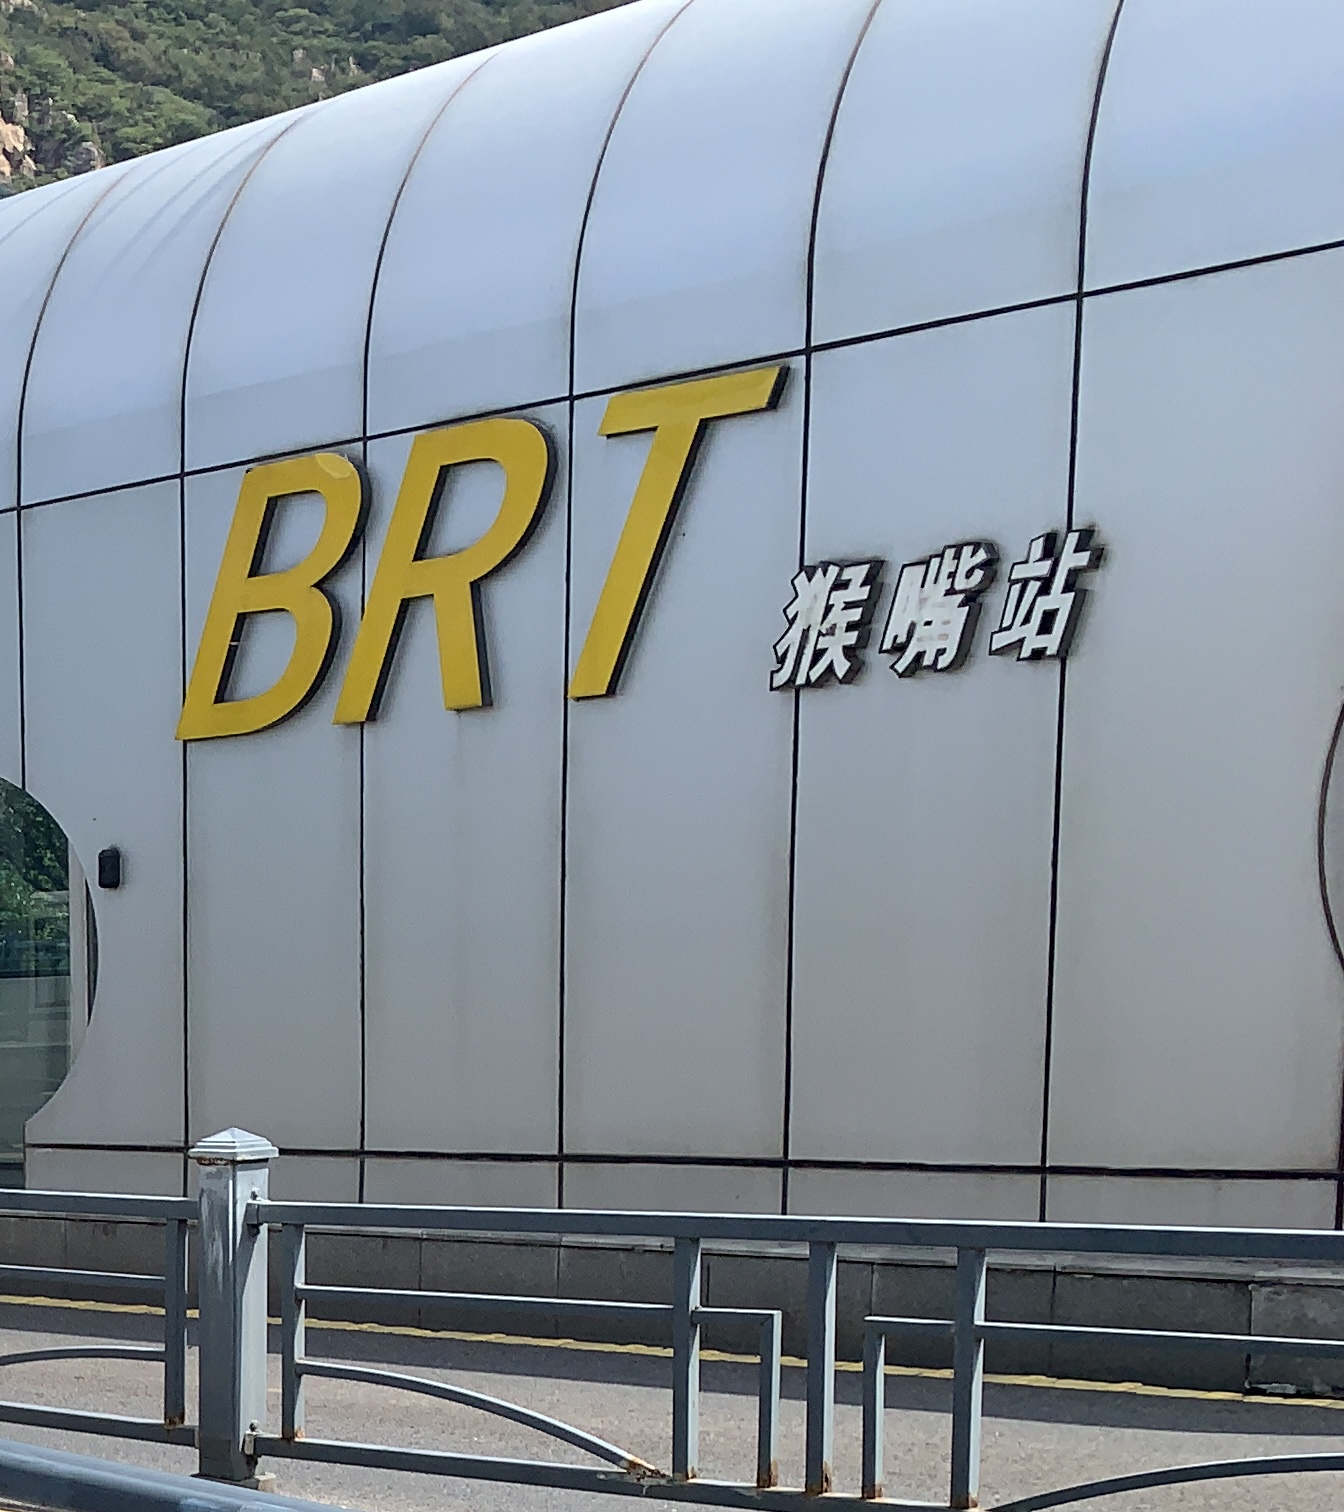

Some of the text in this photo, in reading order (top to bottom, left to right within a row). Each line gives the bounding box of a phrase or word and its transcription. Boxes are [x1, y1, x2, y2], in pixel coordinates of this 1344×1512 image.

[175, 364, 787, 741] BRT
[769, 527, 1100, 692] 猴嘴站
